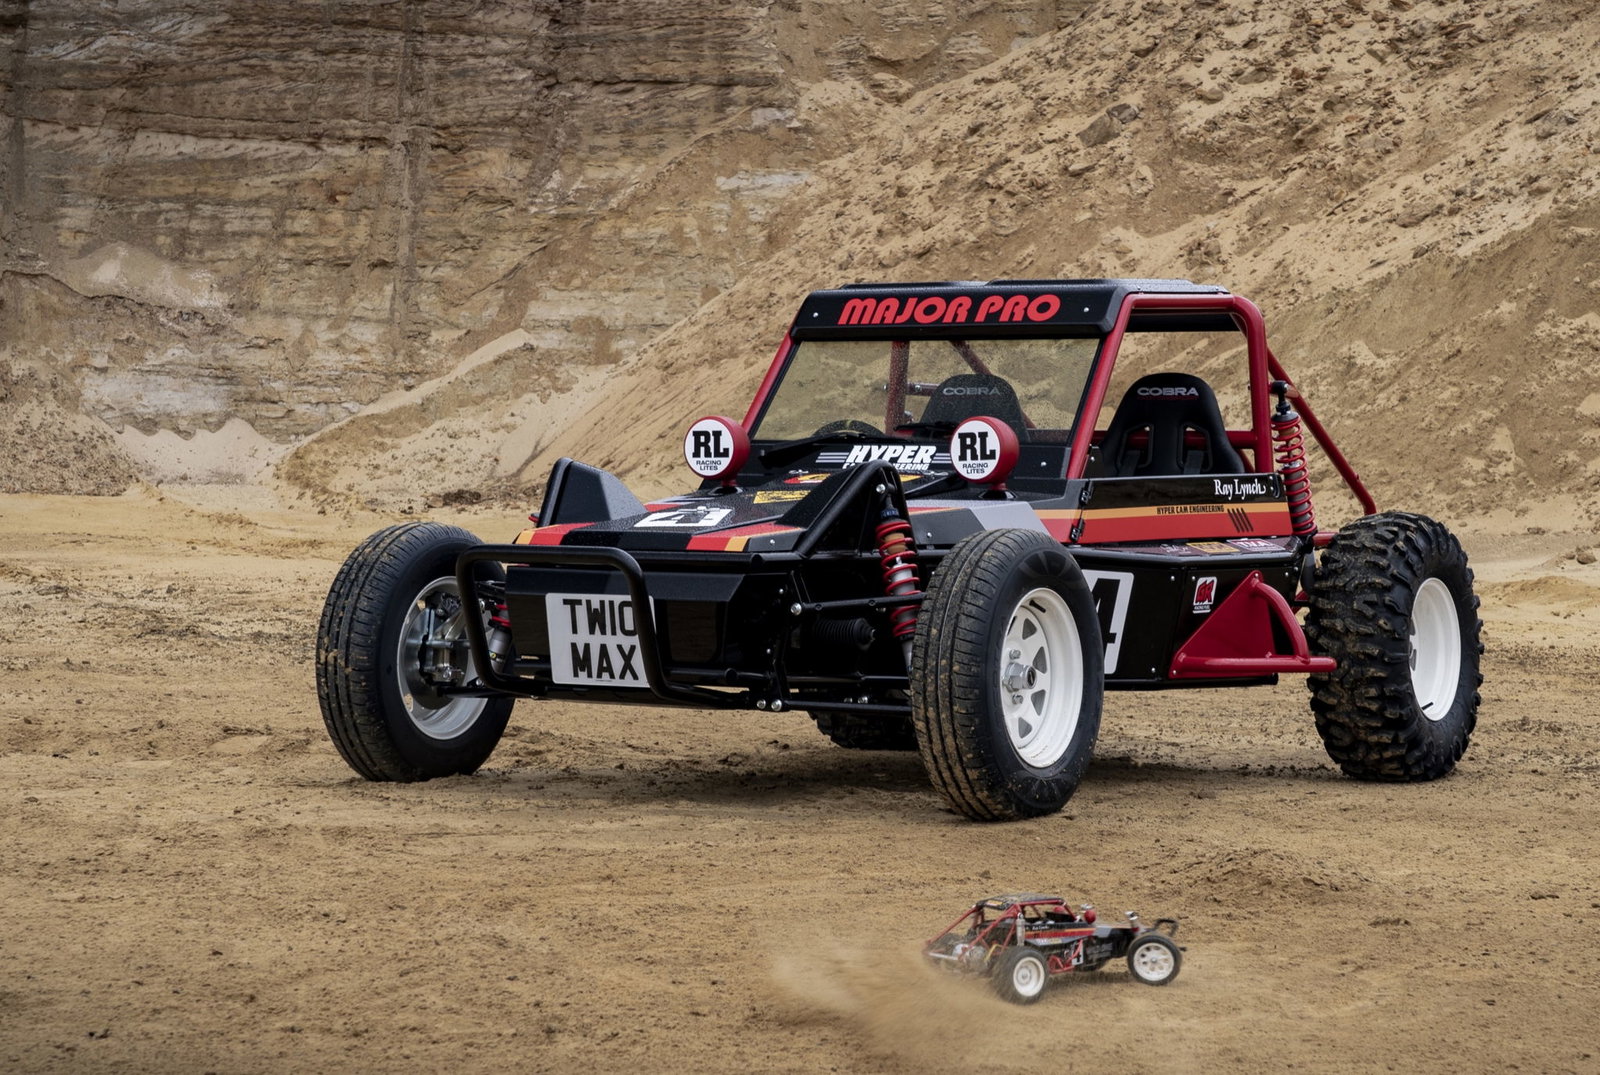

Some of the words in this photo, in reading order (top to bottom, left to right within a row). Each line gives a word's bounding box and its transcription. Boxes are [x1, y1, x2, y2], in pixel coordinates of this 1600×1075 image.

[837, 296, 972, 325] MAJOR
[974, 294, 1061, 323] PRO
[943, 387, 1001, 396] COBRA
[1137, 387, 1199, 397] COBRA
[692, 430, 729, 458] RL
[845, 445, 937, 463] HYPER
[957, 431, 996, 461] RL
[1213, 479, 1233, 500] Ray
[1234, 478, 1267, 500] Lynch
[1157, 507, 1175, 515] HYPER
[1176, 506, 1188, 514] CAM
[1189, 505, 1224, 513] ENGINEERING
[1091, 577, 1121, 661] 4
[570, 642, 639, 680] MAX
